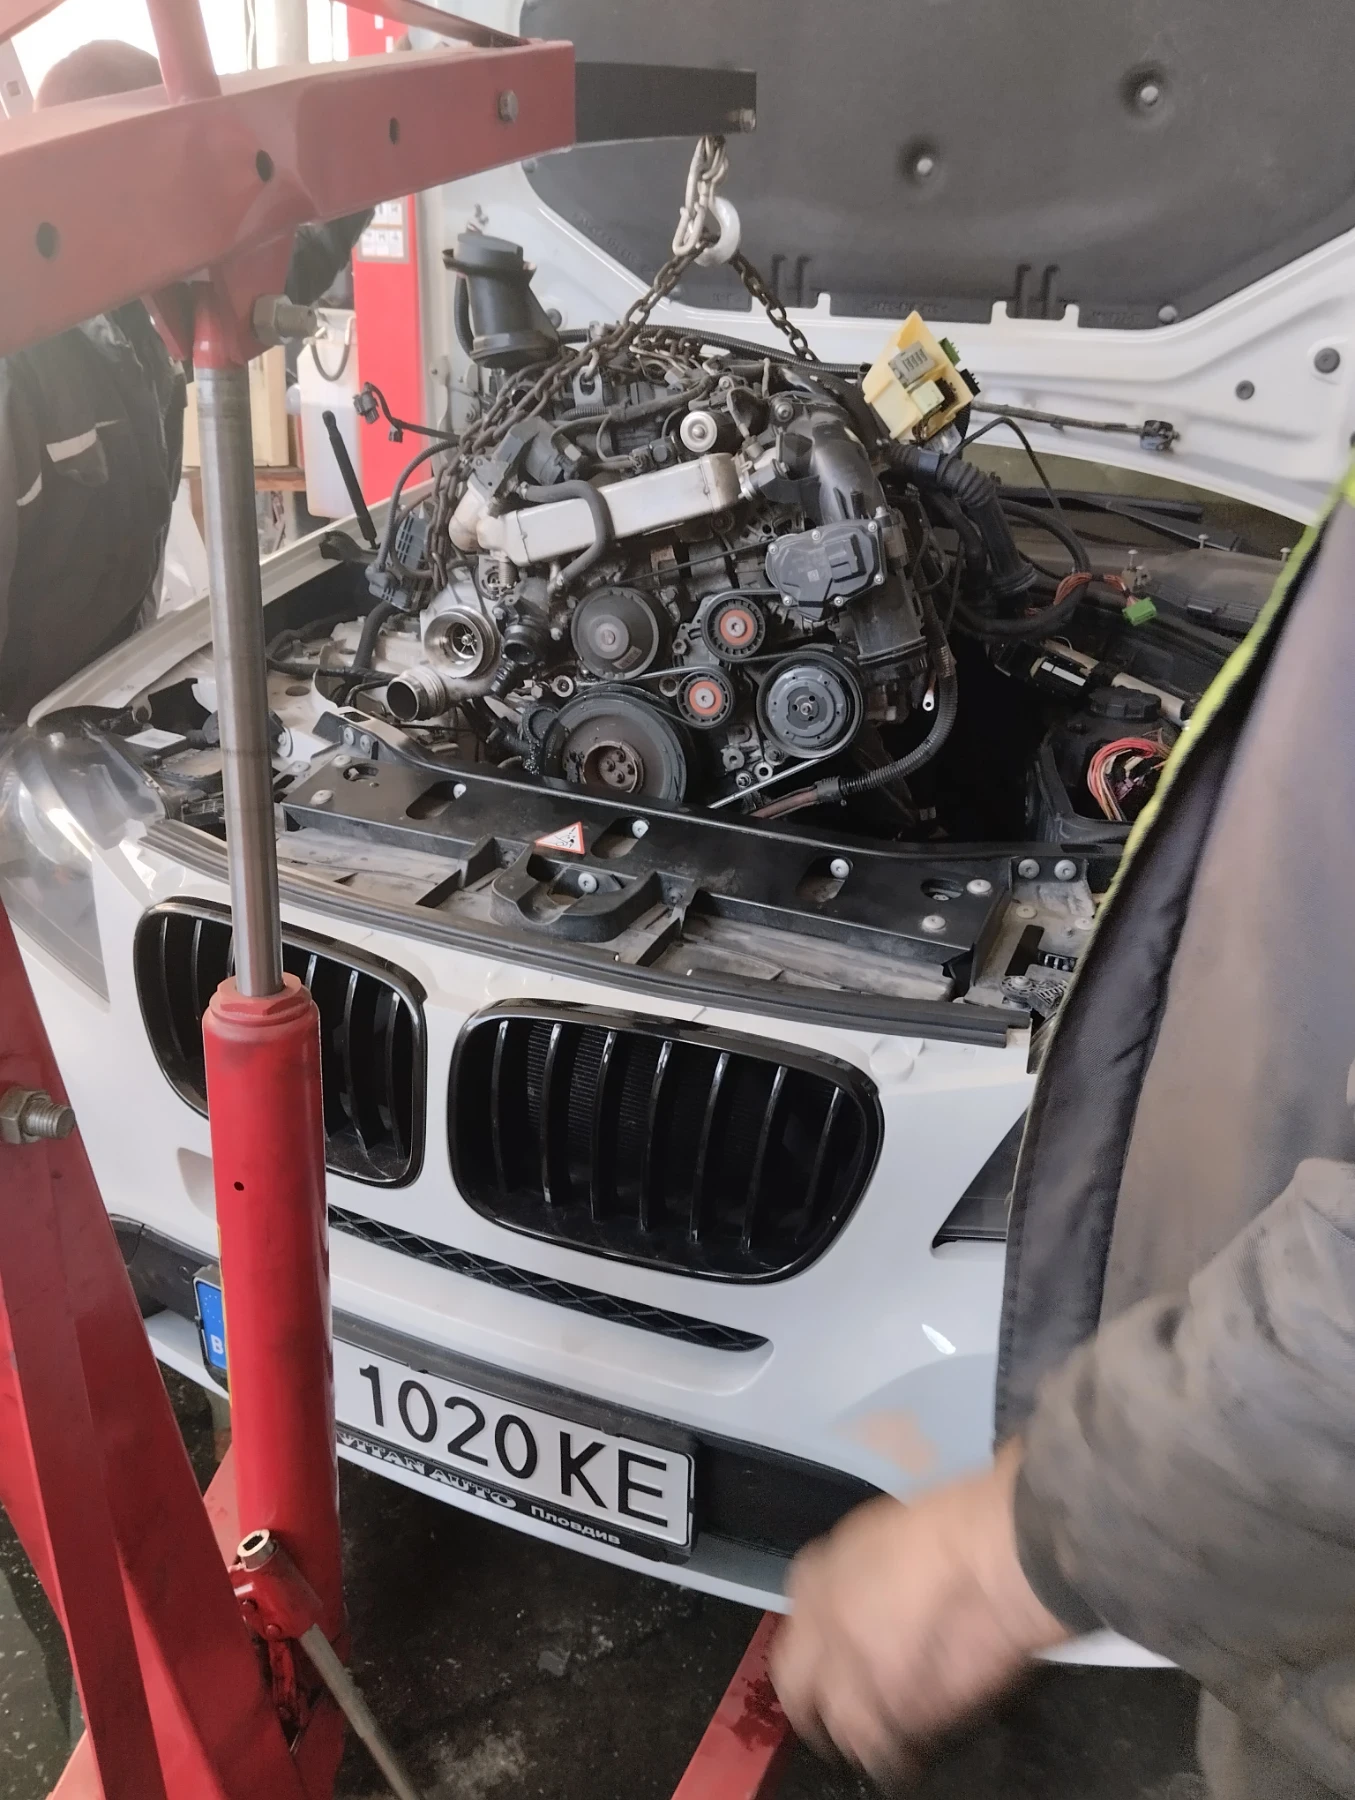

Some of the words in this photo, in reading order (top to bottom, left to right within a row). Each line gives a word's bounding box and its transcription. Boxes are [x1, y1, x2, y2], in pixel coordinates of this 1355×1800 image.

[359, 1364, 538, 1479] 1020
[560, 1431, 668, 1528] KE
[429, 1468, 517, 1508] AUTO
[530, 1505, 621, 1545] Пловдив
